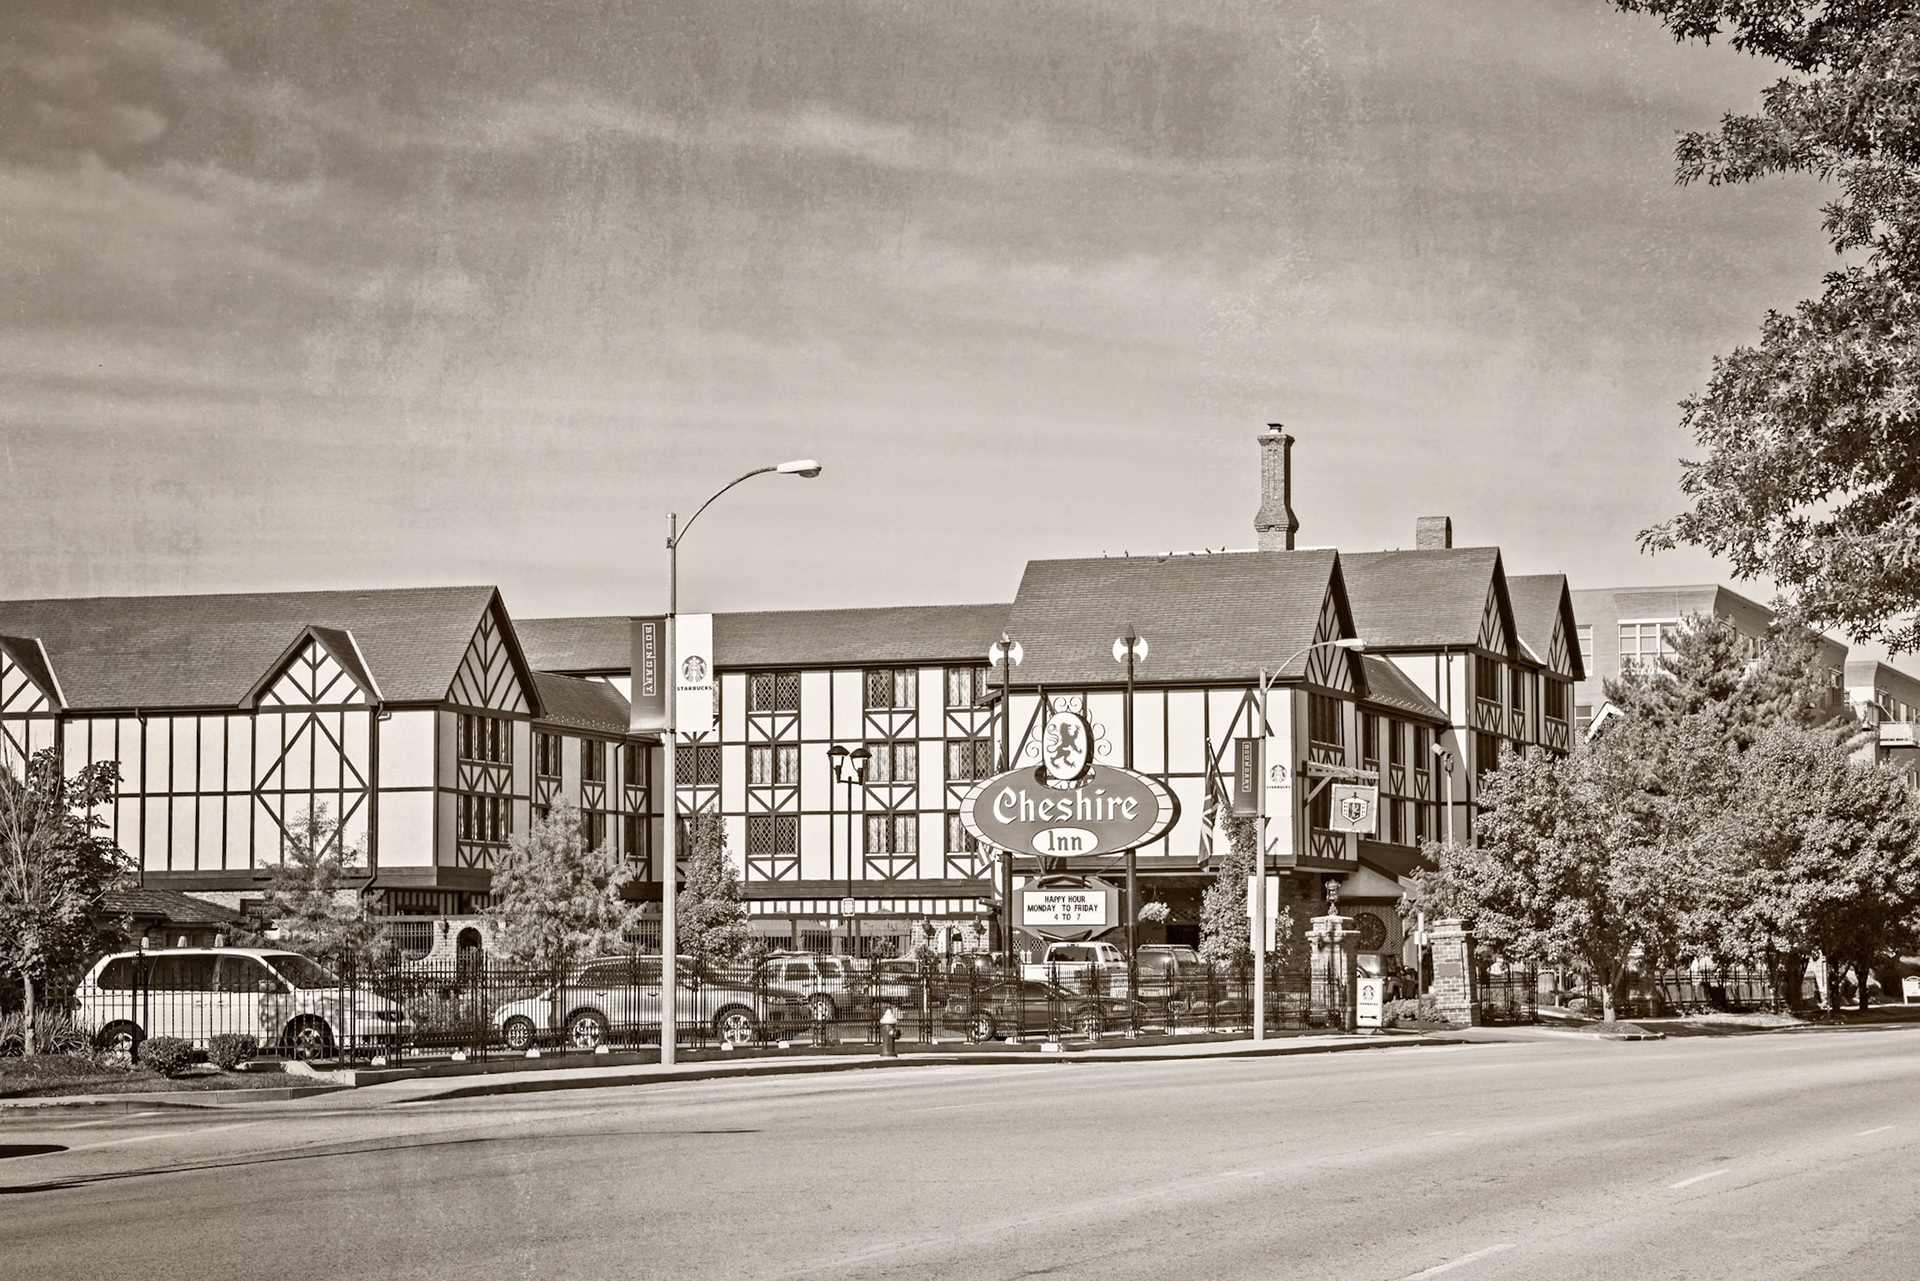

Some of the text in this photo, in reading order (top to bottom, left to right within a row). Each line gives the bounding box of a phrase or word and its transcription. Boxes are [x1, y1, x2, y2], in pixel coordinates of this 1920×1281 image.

[645, 626, 655, 692] BOUNDARY
[993, 786, 1139, 825] Cheshire
[1047, 830, 1083, 851] Inn
[1044, 895, 1086, 903] HAPPY HOUR
[1027, 904, 1098, 912] MONDAY TO FRIDAY
[1054, 913, 1081, 921] 4 TO 7
